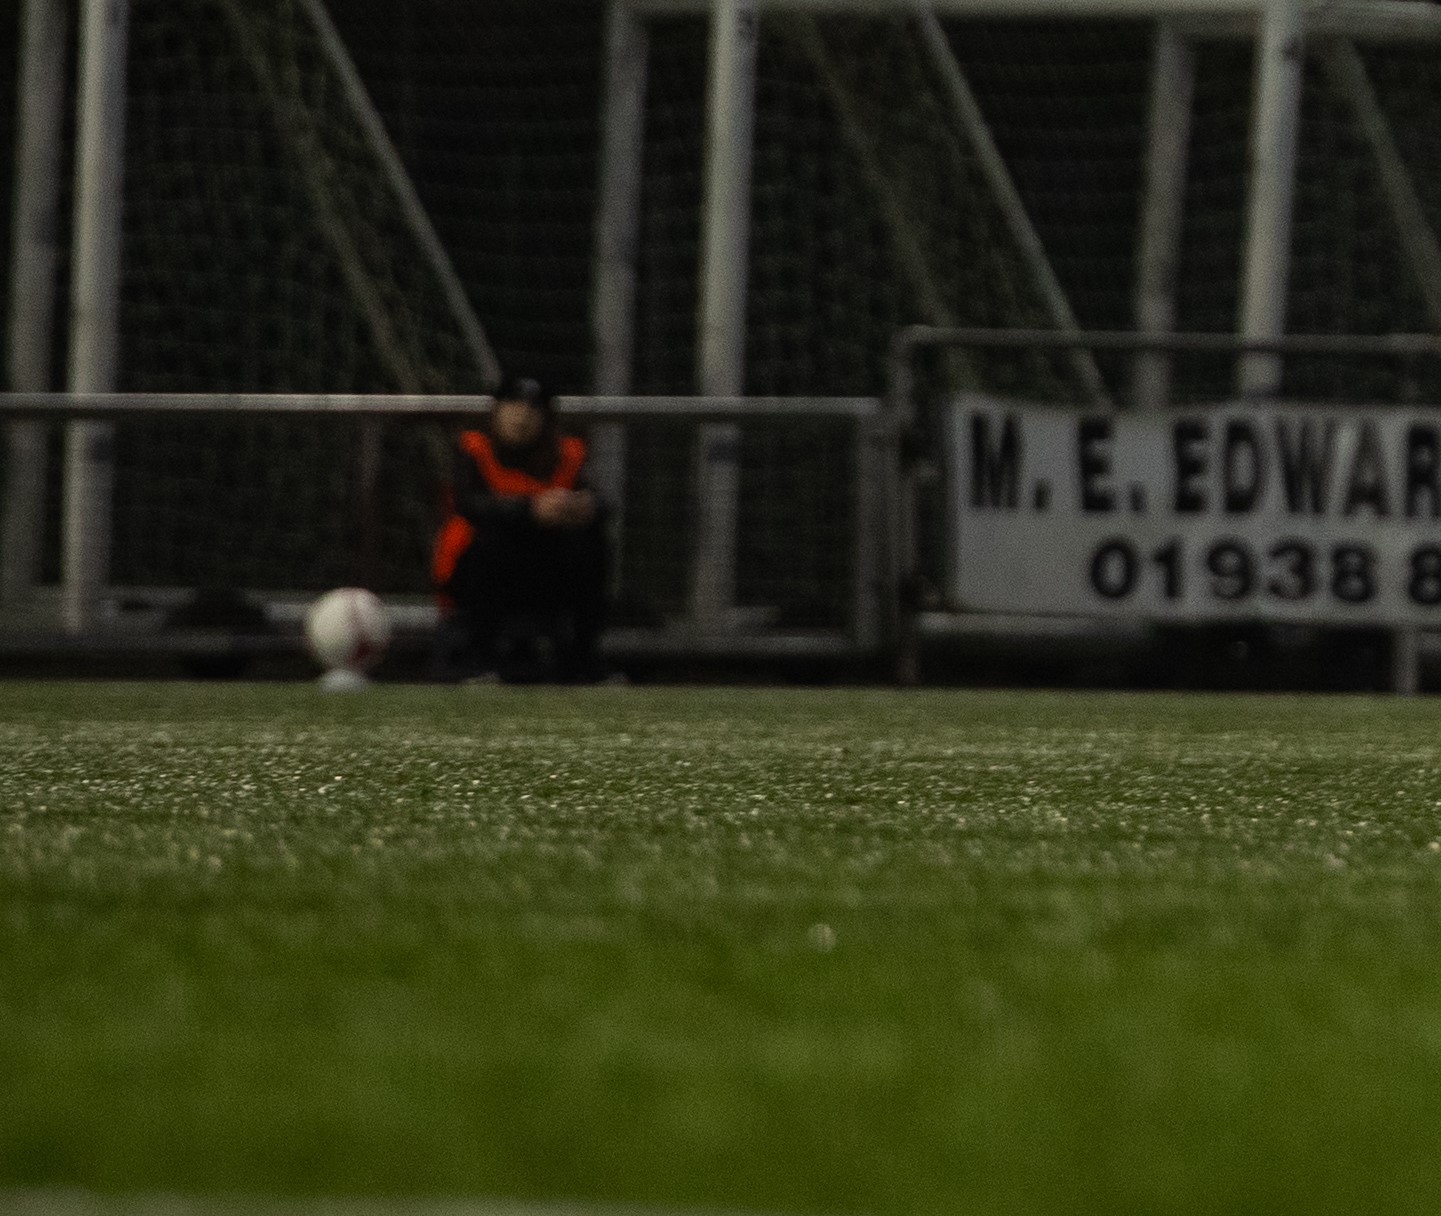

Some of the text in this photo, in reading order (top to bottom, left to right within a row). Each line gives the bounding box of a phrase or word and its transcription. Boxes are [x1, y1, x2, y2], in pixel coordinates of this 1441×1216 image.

[970, 414, 1048, 511] M.
[1079, 418, 1145, 513] E.
[1090, 538, 1375, 604] 01938
